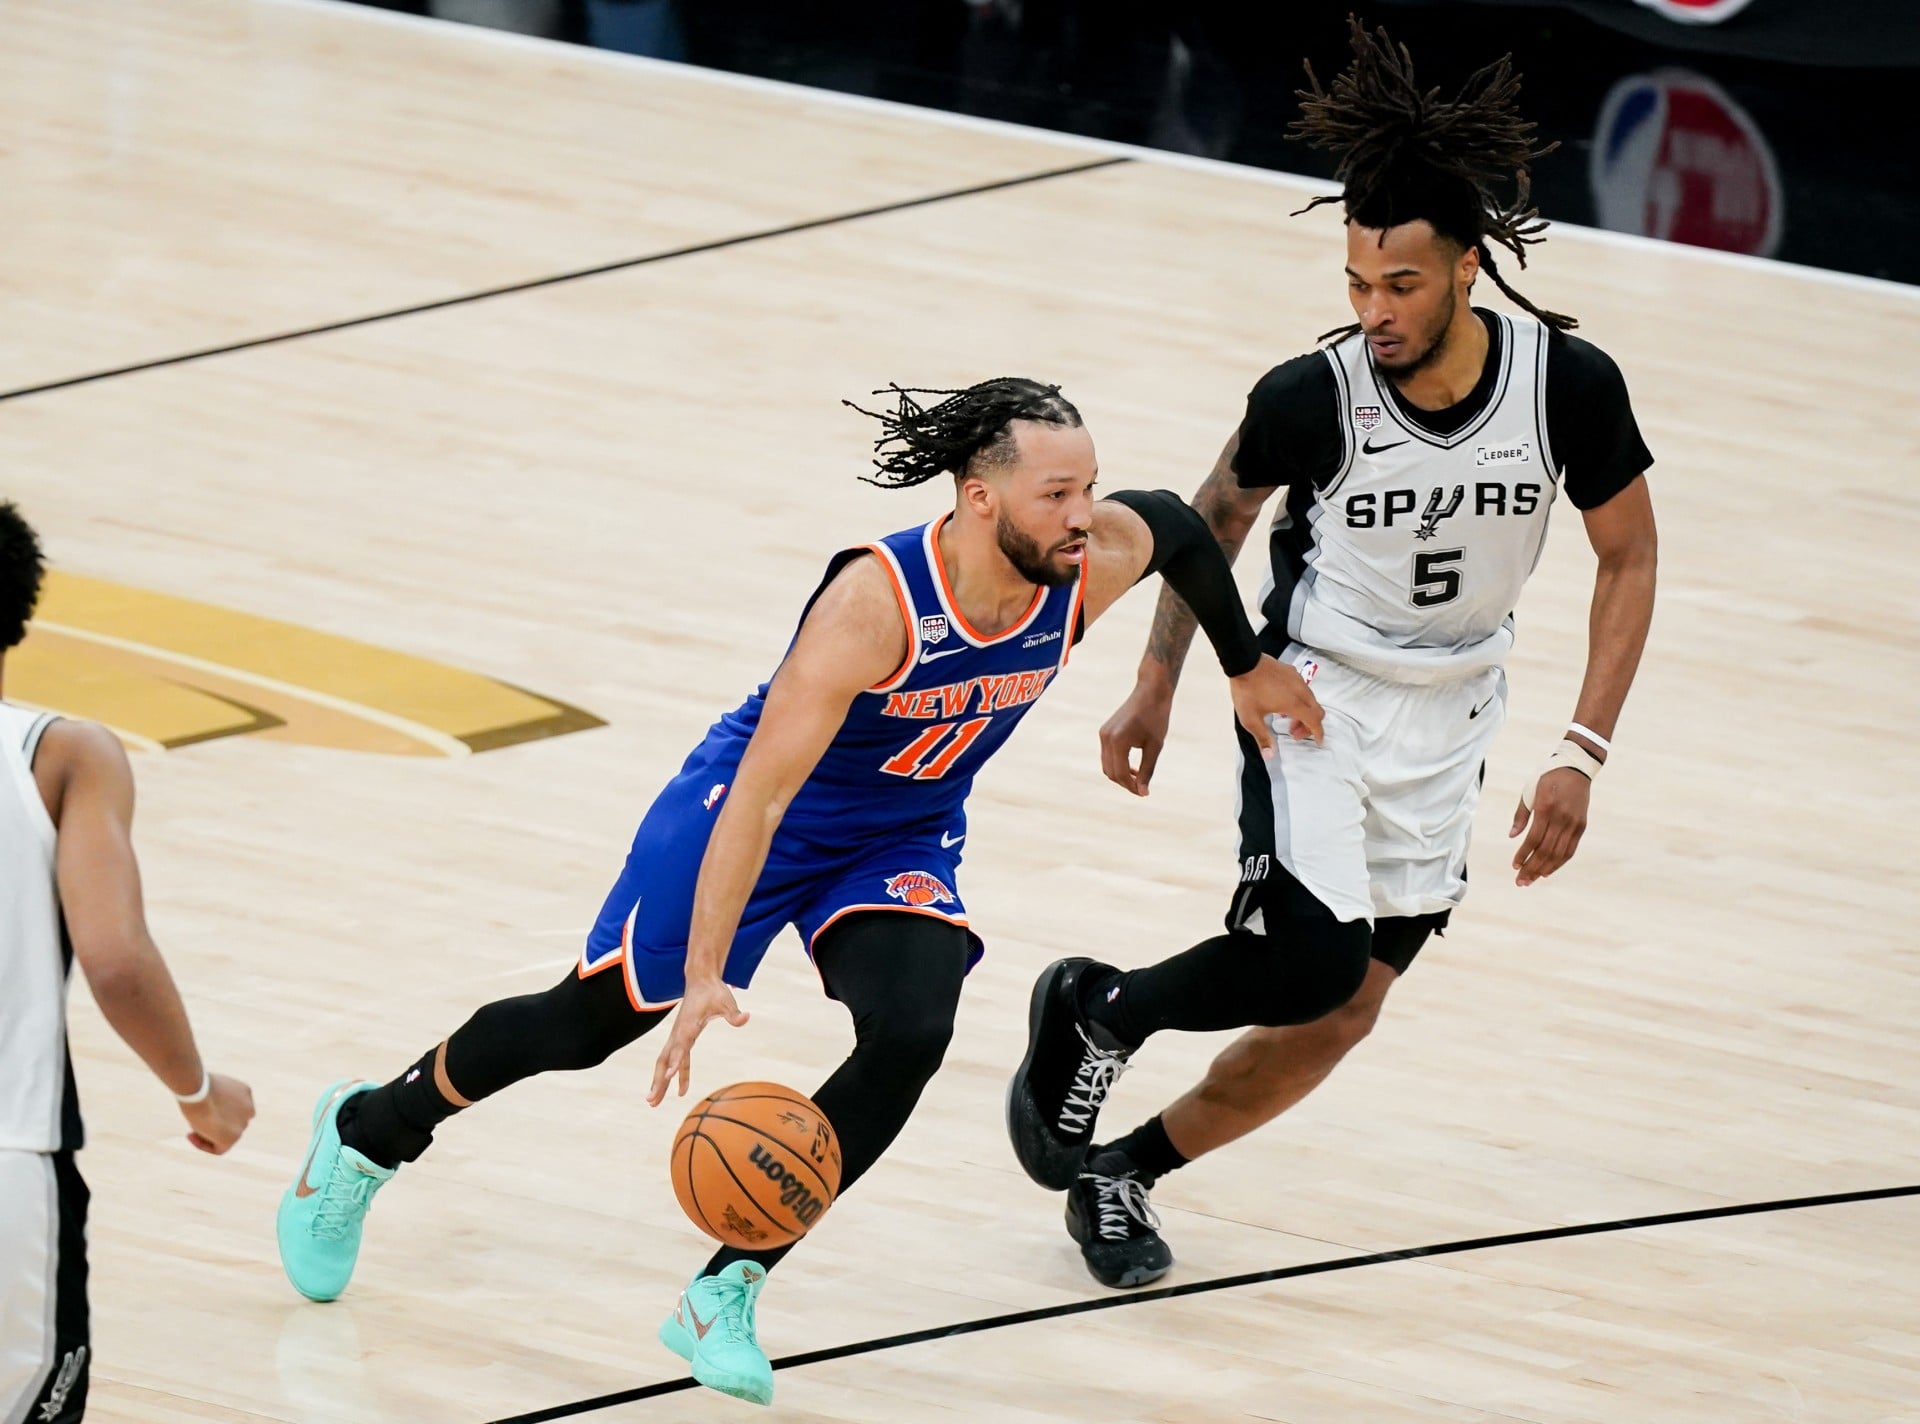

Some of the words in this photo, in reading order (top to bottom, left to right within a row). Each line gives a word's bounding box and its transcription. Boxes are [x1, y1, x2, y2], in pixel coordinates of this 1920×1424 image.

[1484, 449, 1522, 461] LEDGER
[1346, 483, 1541, 541] SPURS
[1409, 547, 1466, 609] 5
[924, 619, 944, 627] USA
[924, 629, 945, 638] 250
[881, 680, 976, 718] NEW
[976, 666, 1058, 713] YORK
[878, 717, 993, 780] 11
[748, 1142, 824, 1227] Wilson
